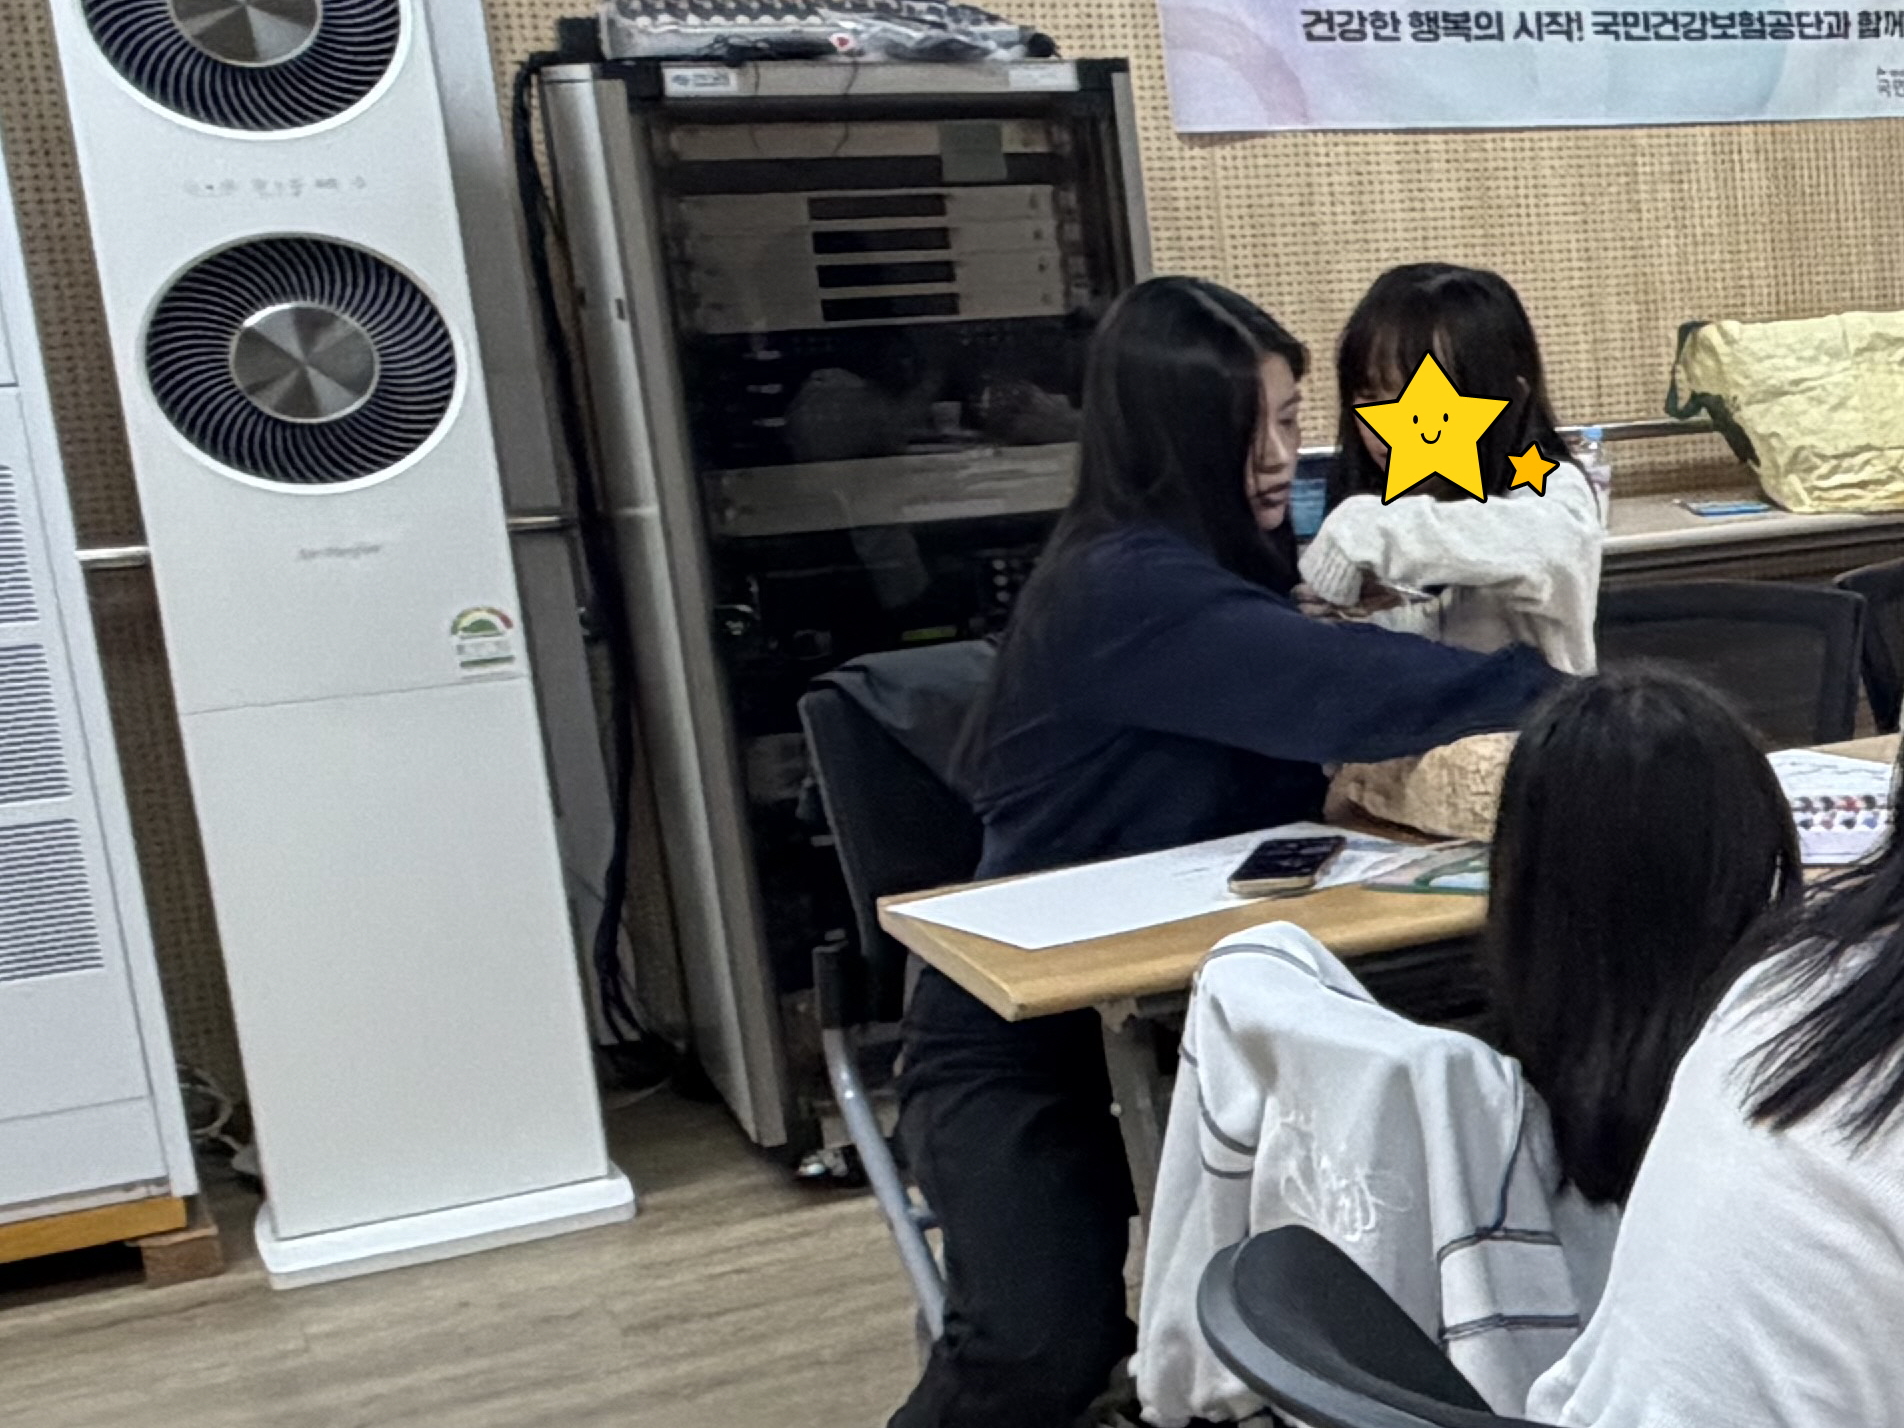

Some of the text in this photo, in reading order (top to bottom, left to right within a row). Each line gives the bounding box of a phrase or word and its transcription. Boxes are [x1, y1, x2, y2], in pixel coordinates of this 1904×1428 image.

[1300, 8, 1401, 42] 건강한
[1407, 9, 1505, 42] 행복의
[1512, 9, 1584, 42] 시작!
[1591, 9, 1851, 41] 국민건강보험공단과
